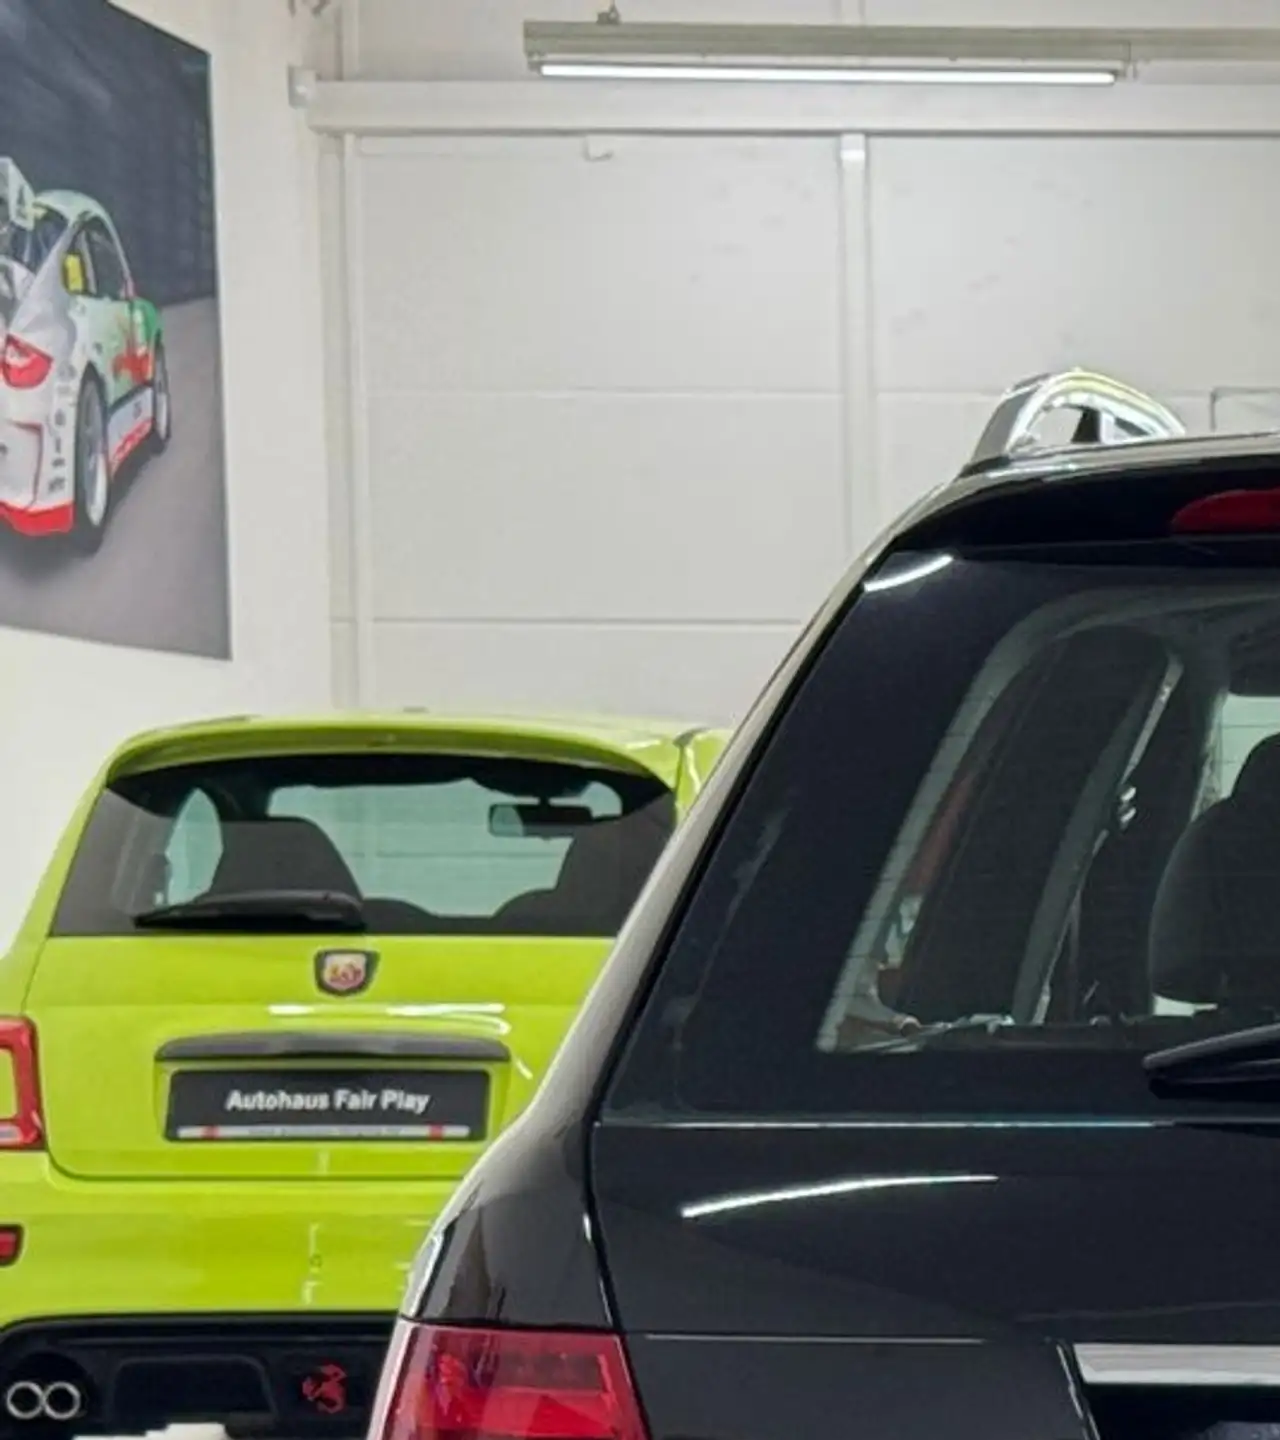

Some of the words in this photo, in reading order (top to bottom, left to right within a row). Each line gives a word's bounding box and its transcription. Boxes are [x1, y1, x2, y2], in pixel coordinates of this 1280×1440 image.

[225, 1088, 330, 1111] Autohaus
[333, 1088, 377, 1111] Fair
[381, 1088, 430, 1114] Play
